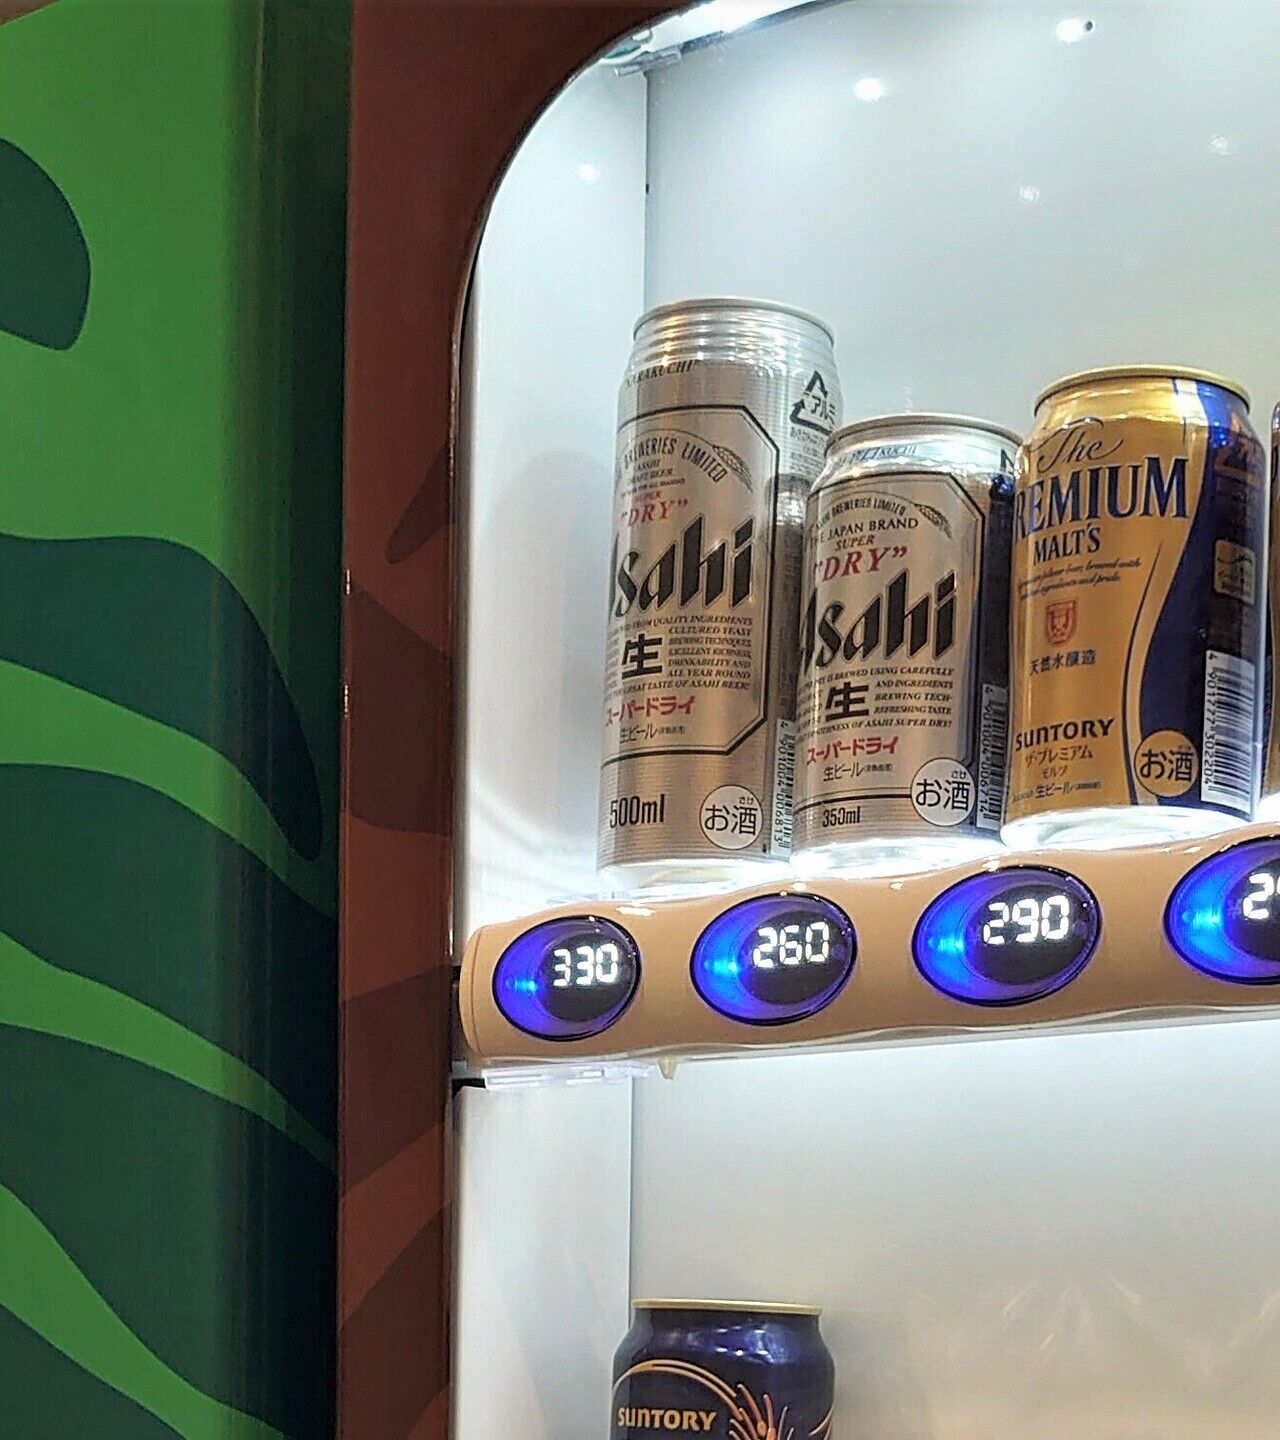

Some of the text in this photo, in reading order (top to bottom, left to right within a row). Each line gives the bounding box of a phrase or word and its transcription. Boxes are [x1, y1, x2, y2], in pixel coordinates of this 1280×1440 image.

[827, 517, 919, 540] JAPAN BRAND
[835, 535, 875, 551] SUPER
[622, 633, 663, 681] 生
[825, 681, 870, 722] 生
[807, 736, 899, 765] スーパードライ
[1139, 749, 1194, 783] お酒
[610, 793, 665, 829] 500ml
[916, 778, 970, 812] お酒
[823, 805, 861, 828] 350ml
[982, 895, 1070, 947] 290
[751, 920, 830, 970] 260
[553, 943, 619, 988] 330
